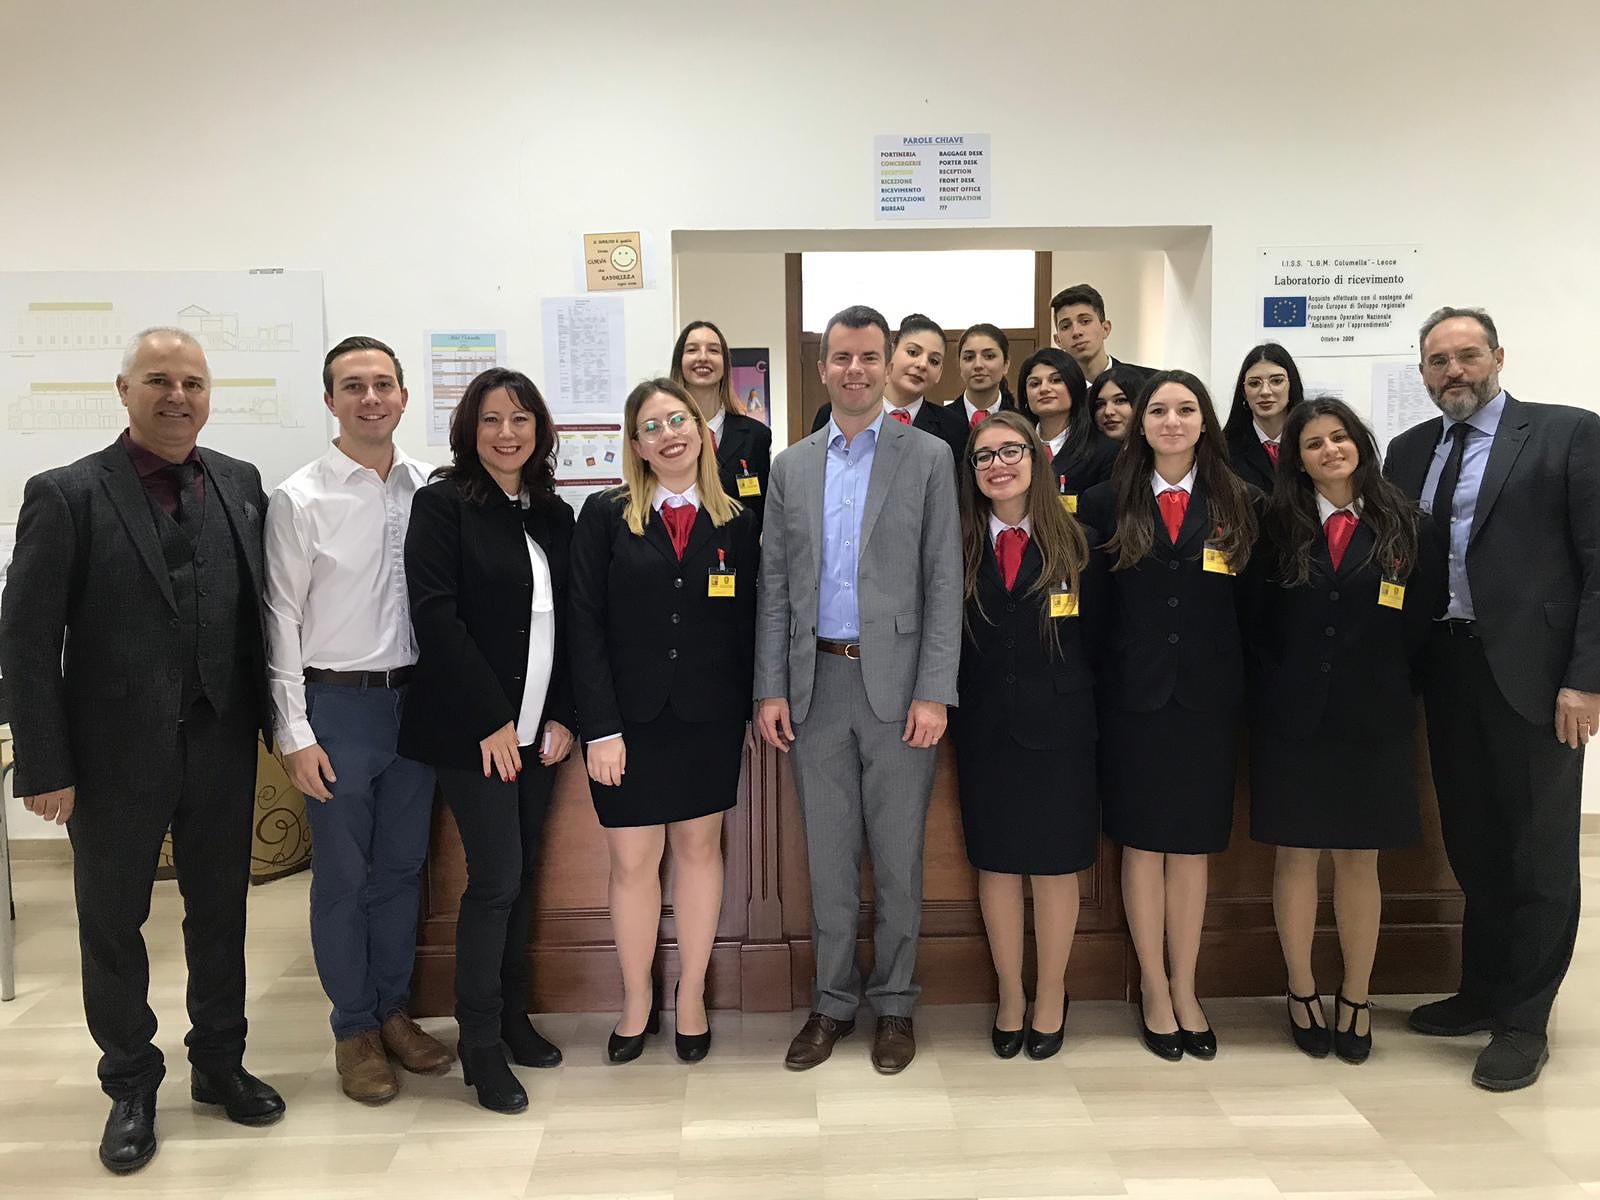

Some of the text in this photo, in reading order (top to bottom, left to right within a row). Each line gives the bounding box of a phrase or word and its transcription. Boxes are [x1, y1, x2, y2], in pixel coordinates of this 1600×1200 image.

[935, 136, 964, 144] CHIAVE
[1274, 274, 1404, 286] Laboratorio di ricevimento
[1308, 314, 1337, 322] Programma
